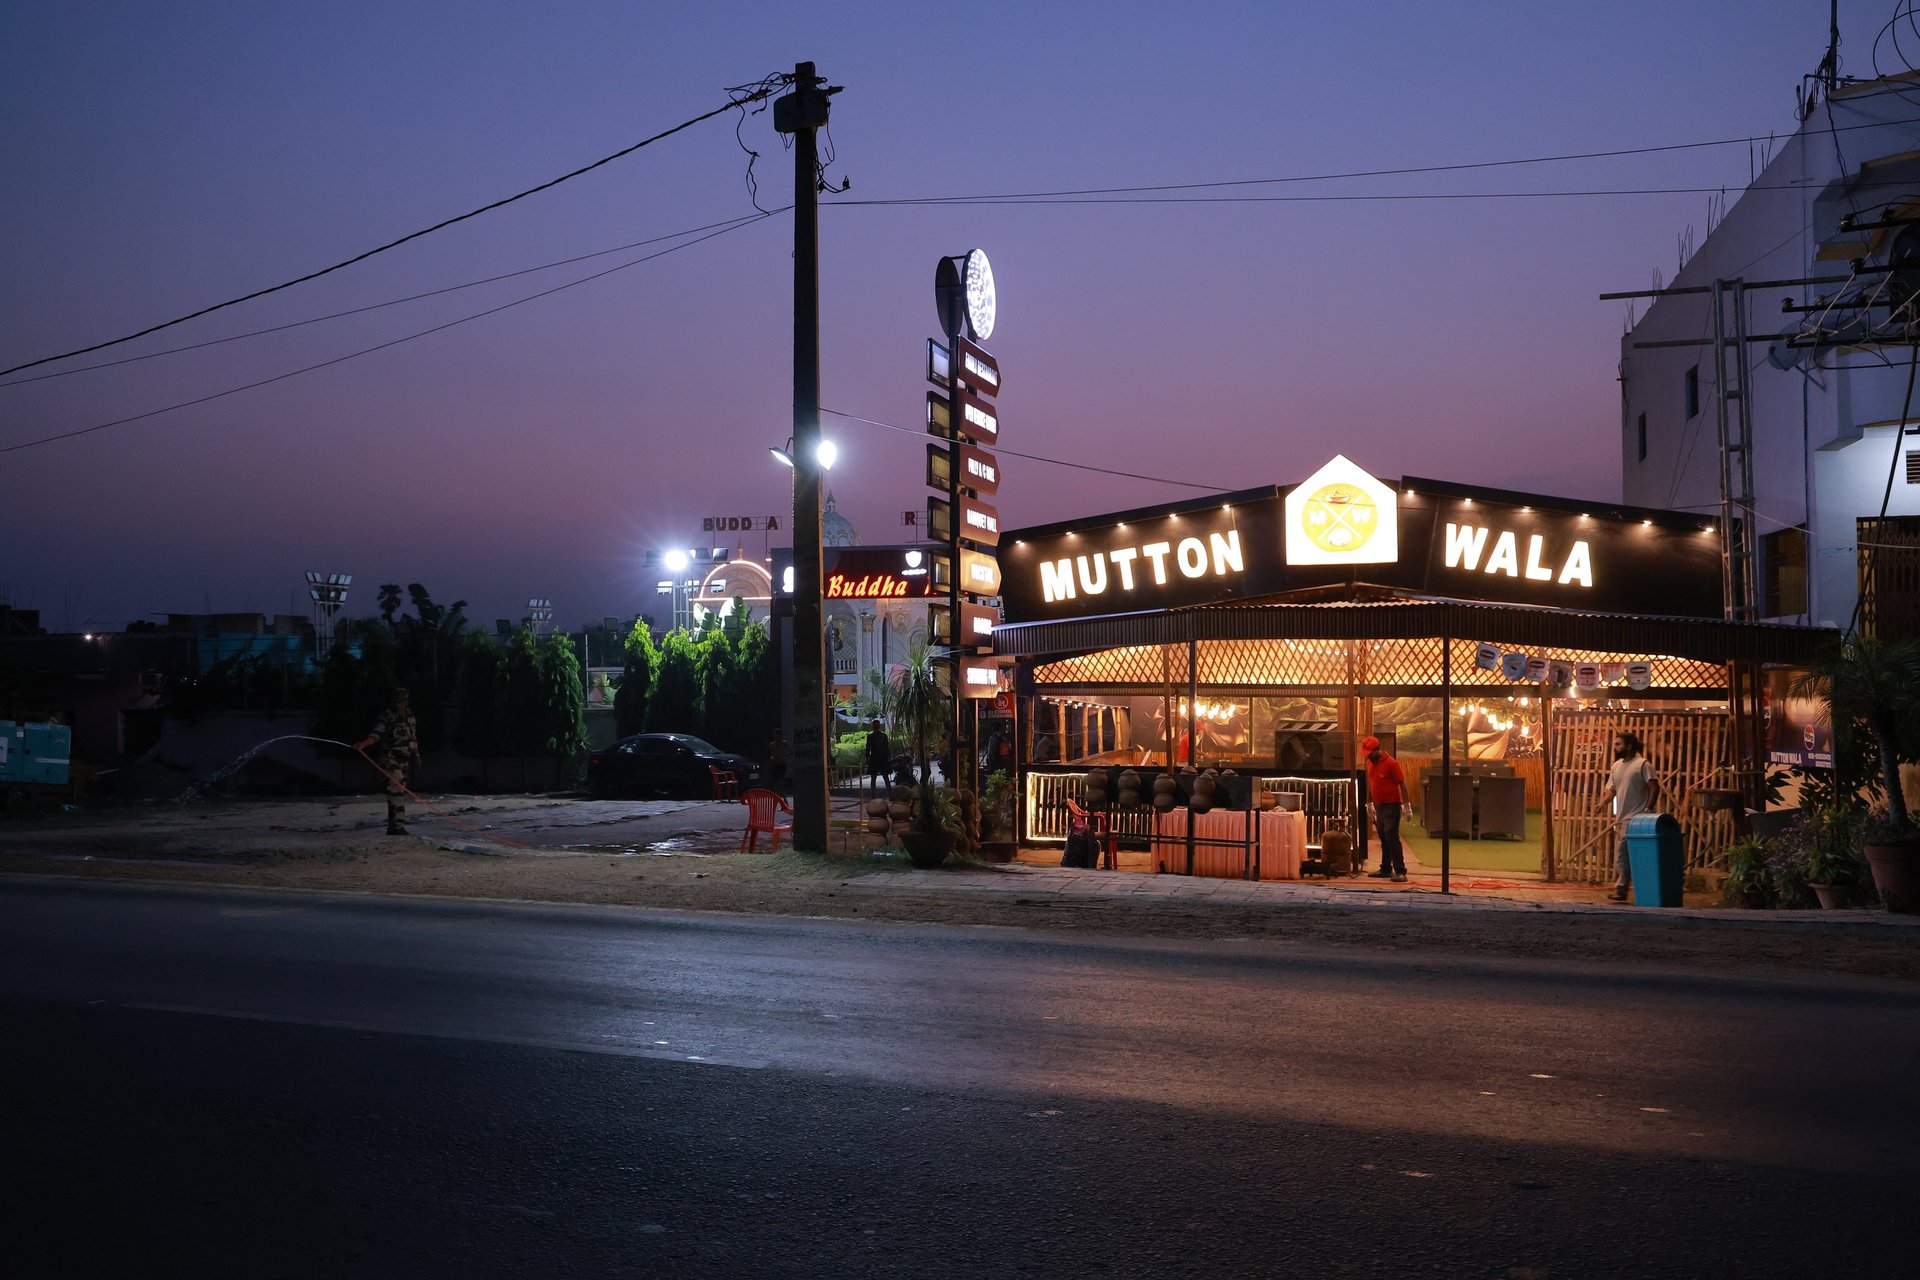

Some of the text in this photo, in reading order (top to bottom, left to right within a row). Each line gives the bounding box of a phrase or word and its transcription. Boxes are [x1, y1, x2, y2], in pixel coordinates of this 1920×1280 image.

[1310, 508, 1371, 525] M W
[1040, 522, 1594, 604] MUTTON WALA
[827, 575, 908, 598] Buddha
